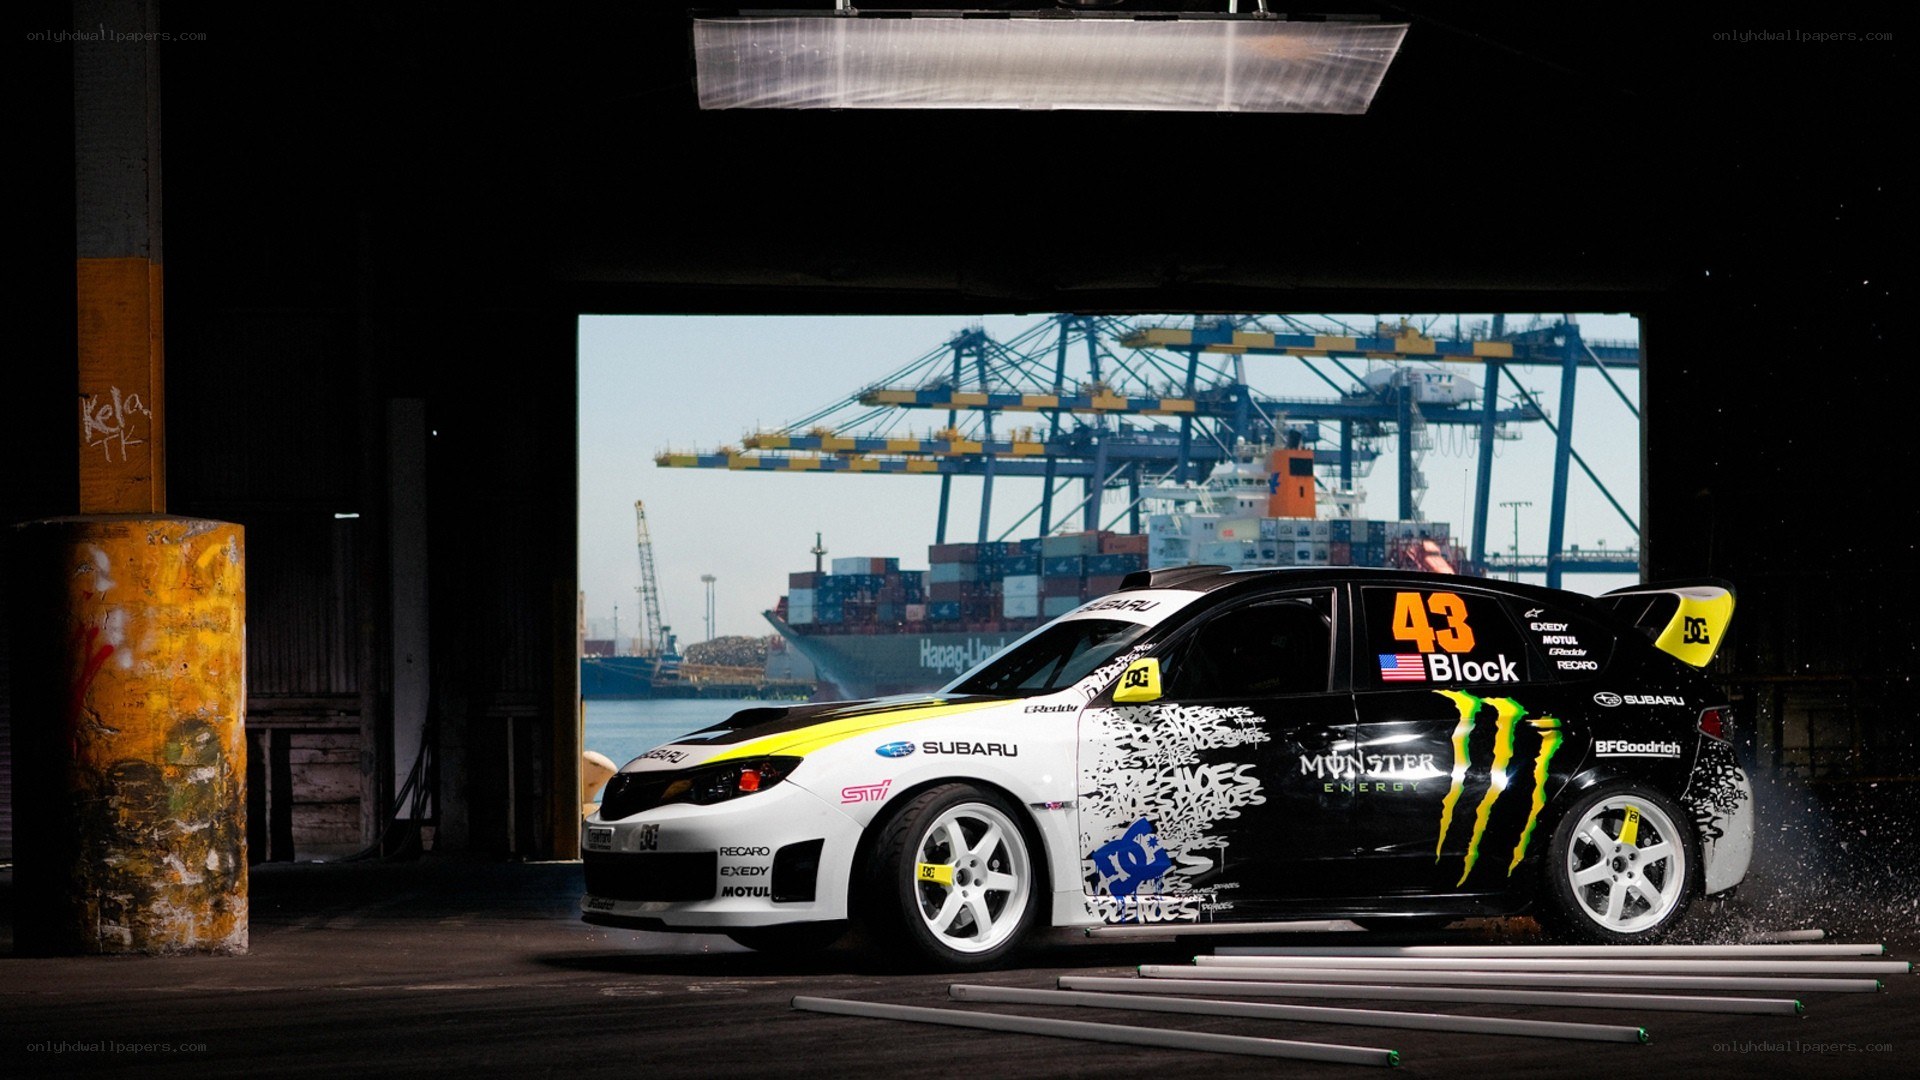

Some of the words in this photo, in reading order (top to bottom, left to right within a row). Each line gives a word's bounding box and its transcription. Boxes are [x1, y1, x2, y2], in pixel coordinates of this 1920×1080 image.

[1392, 592, 1475, 653] 43
[1530, 622, 1568, 632] EXEDY
[1542, 635, 1579, 646] MOTUL
[1548, 647, 1587, 657] GReddy
[1428, 653, 1520, 682] Block
[1556, 660, 1598, 671] RECARO
[1623, 694, 1686, 706] SUBARU
[1024, 704, 1079, 714] GReddy
[922, 741, 1019, 758] SUBARU
[1595, 740, 1682, 754] BFGoodrich
[1299, 750, 1434, 780] MONSTER
[1323, 782, 1421, 793] ENERGY
[720, 846, 770, 856] RECARO
[720, 866, 770, 876] EXEDY
[721, 886, 771, 897] MOTUL
